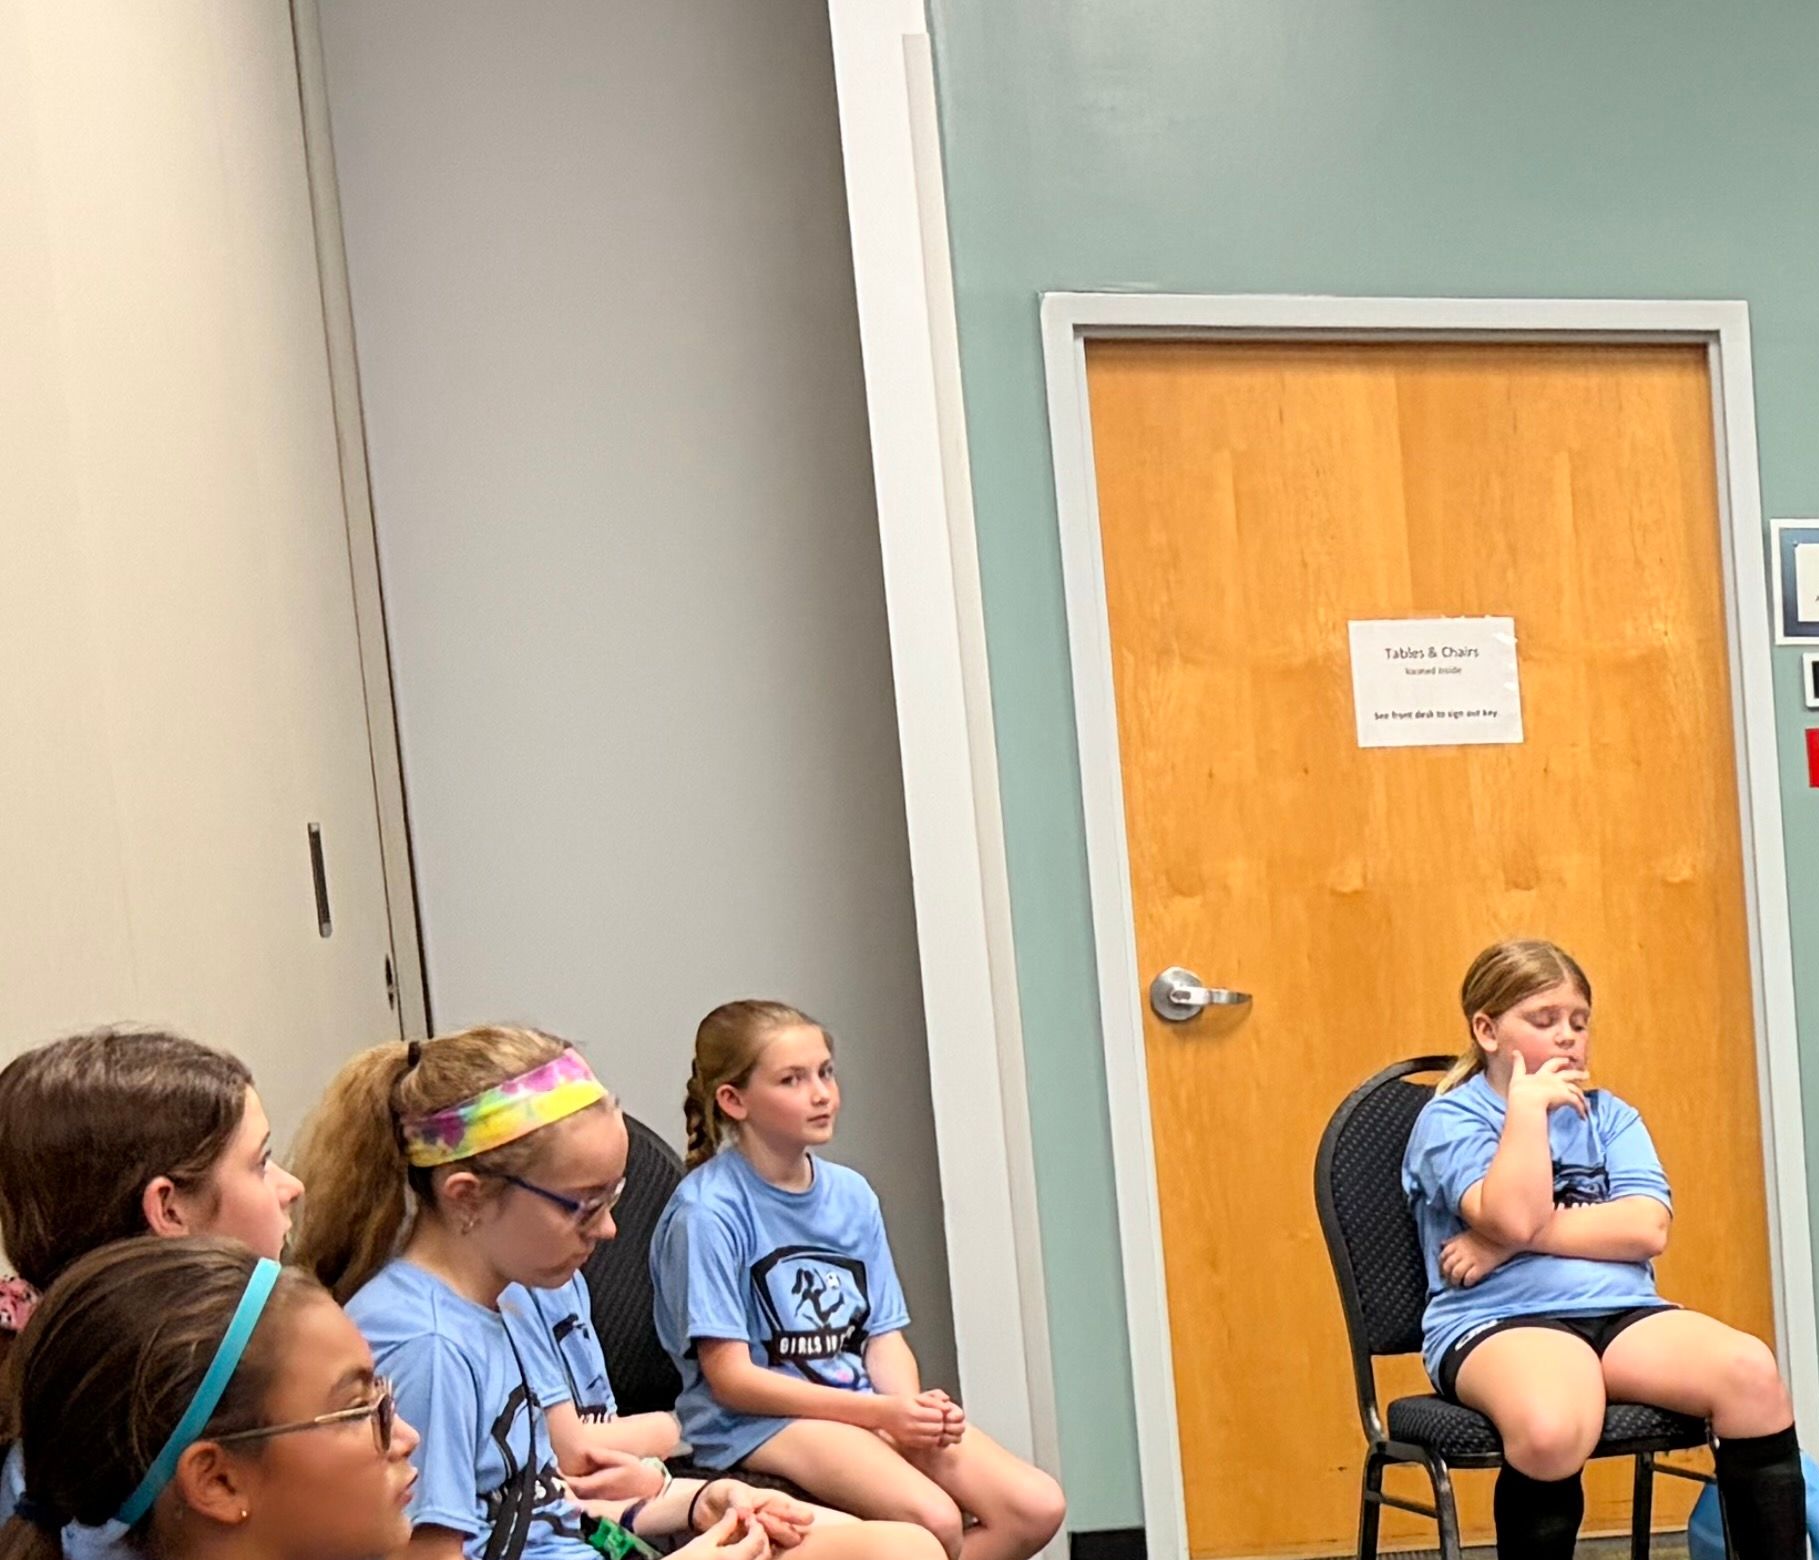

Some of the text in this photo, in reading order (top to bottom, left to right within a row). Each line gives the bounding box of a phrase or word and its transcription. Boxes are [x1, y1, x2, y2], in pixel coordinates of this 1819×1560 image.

[1384, 645, 1480, 660] Tables & Chairs
[779, 1335, 822, 1356] GIRLS
